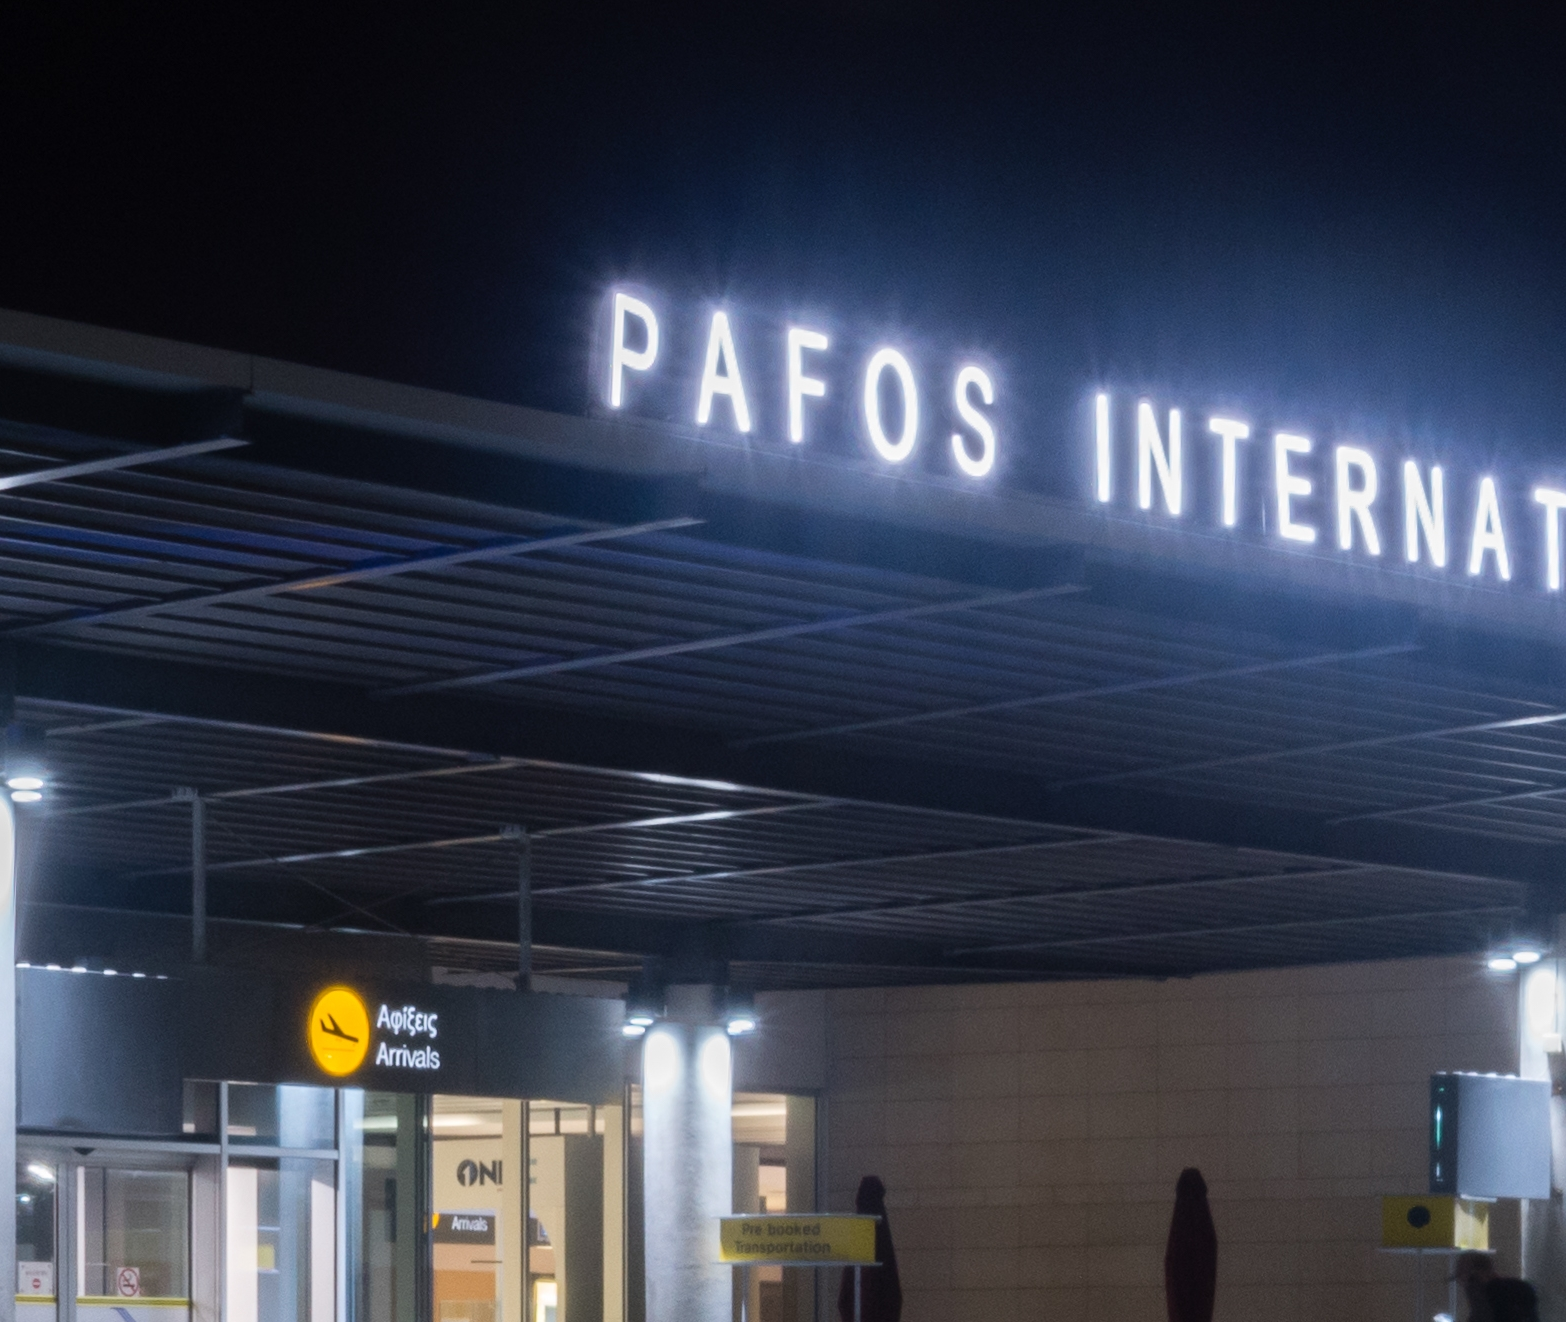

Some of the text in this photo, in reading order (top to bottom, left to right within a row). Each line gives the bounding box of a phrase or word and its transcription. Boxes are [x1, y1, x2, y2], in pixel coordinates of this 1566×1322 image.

[610, 292, 997, 477] PAFOS
[376, 1004, 438, 1038] Αφίξεις
[375, 1041, 440, 1069] Arrivals
[451, 1216, 488, 1232] Arrivals
[767, 1223, 821, 1236] booked
[735, 1241, 831, 1254] Transportation
